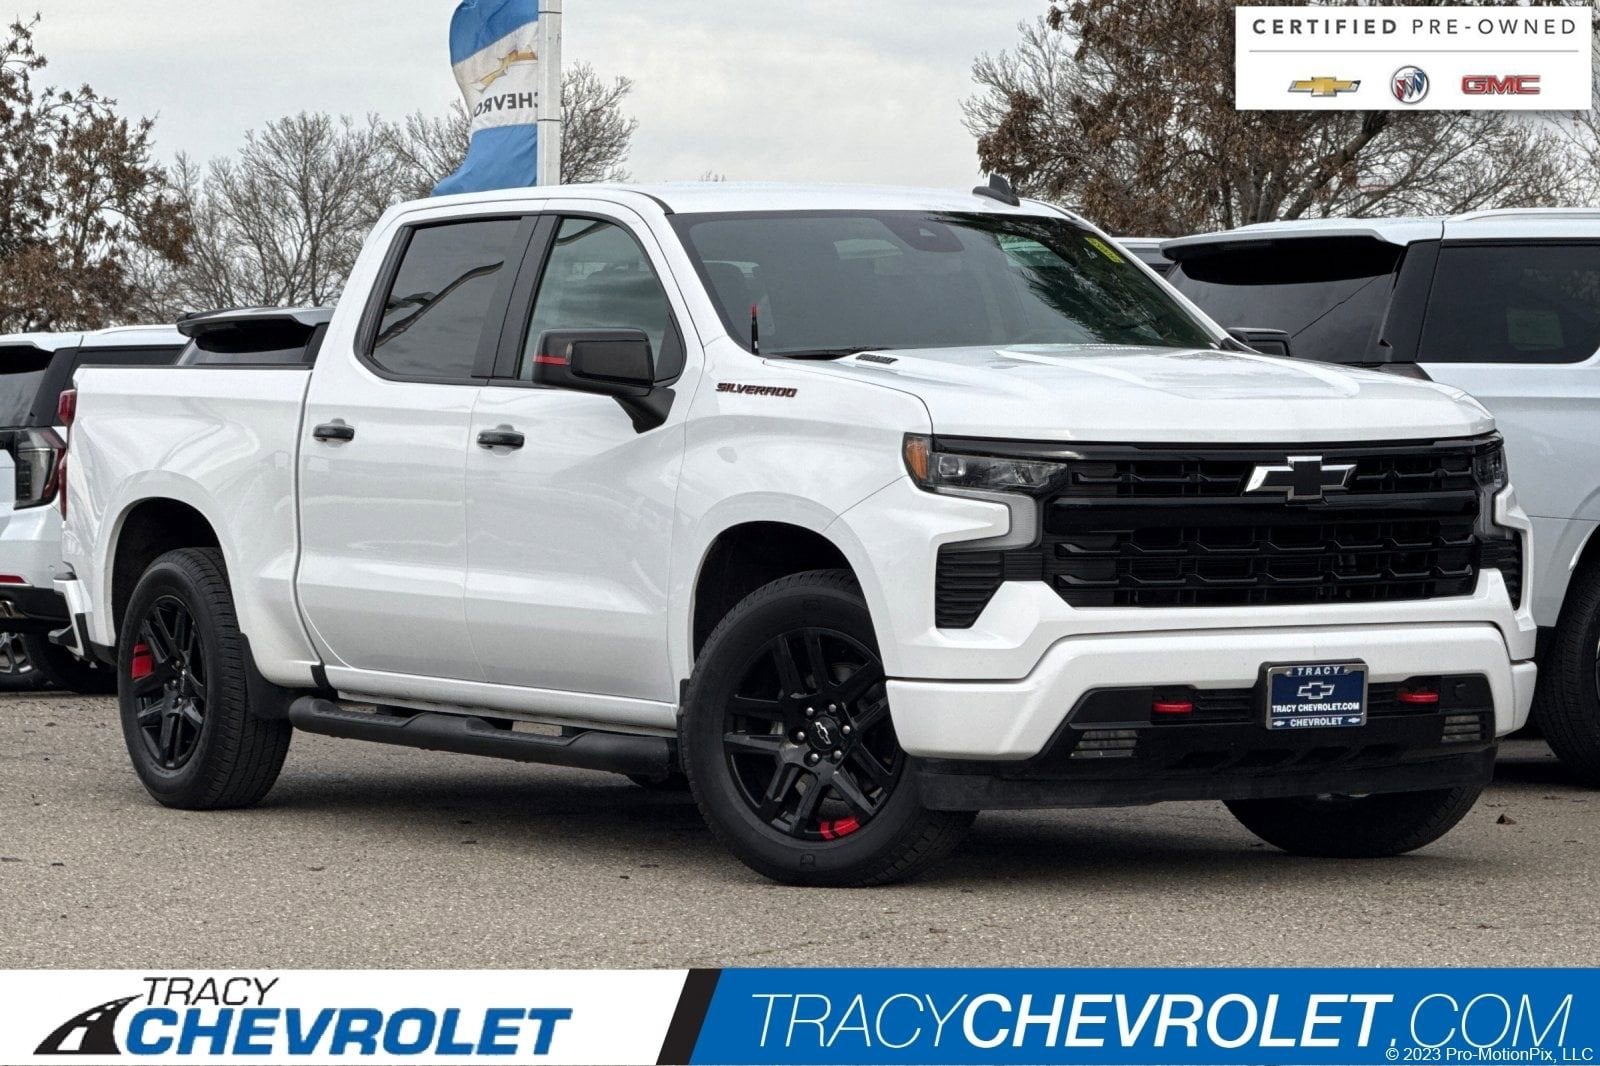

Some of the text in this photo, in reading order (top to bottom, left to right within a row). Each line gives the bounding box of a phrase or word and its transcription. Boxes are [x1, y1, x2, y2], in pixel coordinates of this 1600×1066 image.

[715, 382, 798, 398] SILVERADO
[1297, 666, 1340, 676] TRACY
[1272, 702, 1360, 713] TRACY CHEVROLET.COM
[1290, 717, 1343, 727] CHEVROLET
